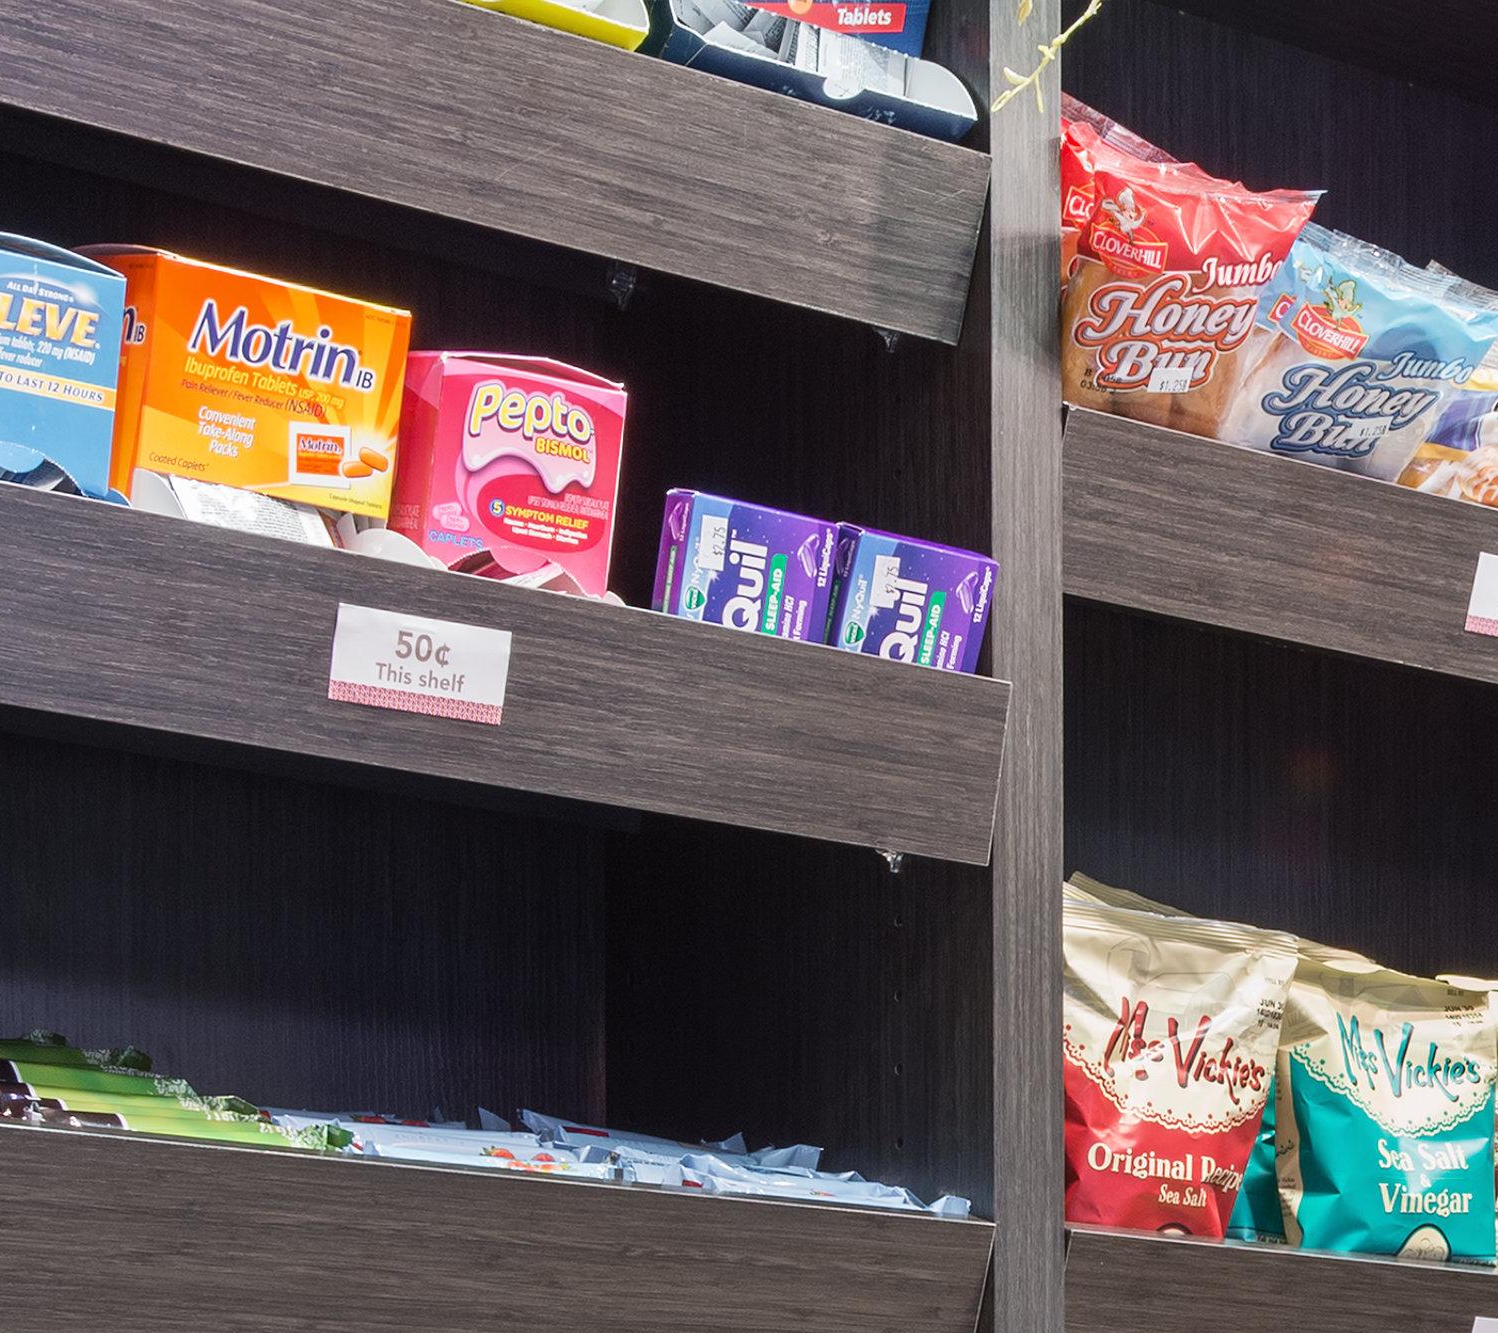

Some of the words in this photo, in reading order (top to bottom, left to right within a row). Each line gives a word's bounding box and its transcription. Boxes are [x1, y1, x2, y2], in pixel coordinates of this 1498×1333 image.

[837, 6, 892, 26] Tablets
[1093, 231, 1162, 270] CLOVERHILL
[1077, 283, 1257, 345] Honey
[189, 300, 359, 386] Motrin
[355, 370, 373, 390] IB
[1296, 308, 1359, 356] CLOVERHILL
[1379, 352, 1473, 384] Jumbo
[16, 374, 44, 390] LAST
[46, 381, 59, 392] 12
[63, 385, 103, 402] HOURS
[1266, 364, 1436, 422] Honey
[197, 406, 257, 430] Convenient
[469, 380, 592, 442] Pepto
[208, 441, 240, 458] Packs
[535, 437, 591, 464] BISMOL
[764, 568, 783, 632] SLEEP-AID
[394, 631, 451, 667] 50¢
[375, 664, 415, 685] This
[419, 669, 465, 693] shelf
[1376, 1138, 1414, 1170] Sea
[1418, 1143, 1469, 1171] Salt
[1158, 1184, 1181, 1204] Sea
[1182, 1187, 1208, 1208] Salt
[1378, 1182, 1473, 1218] Vinegar
